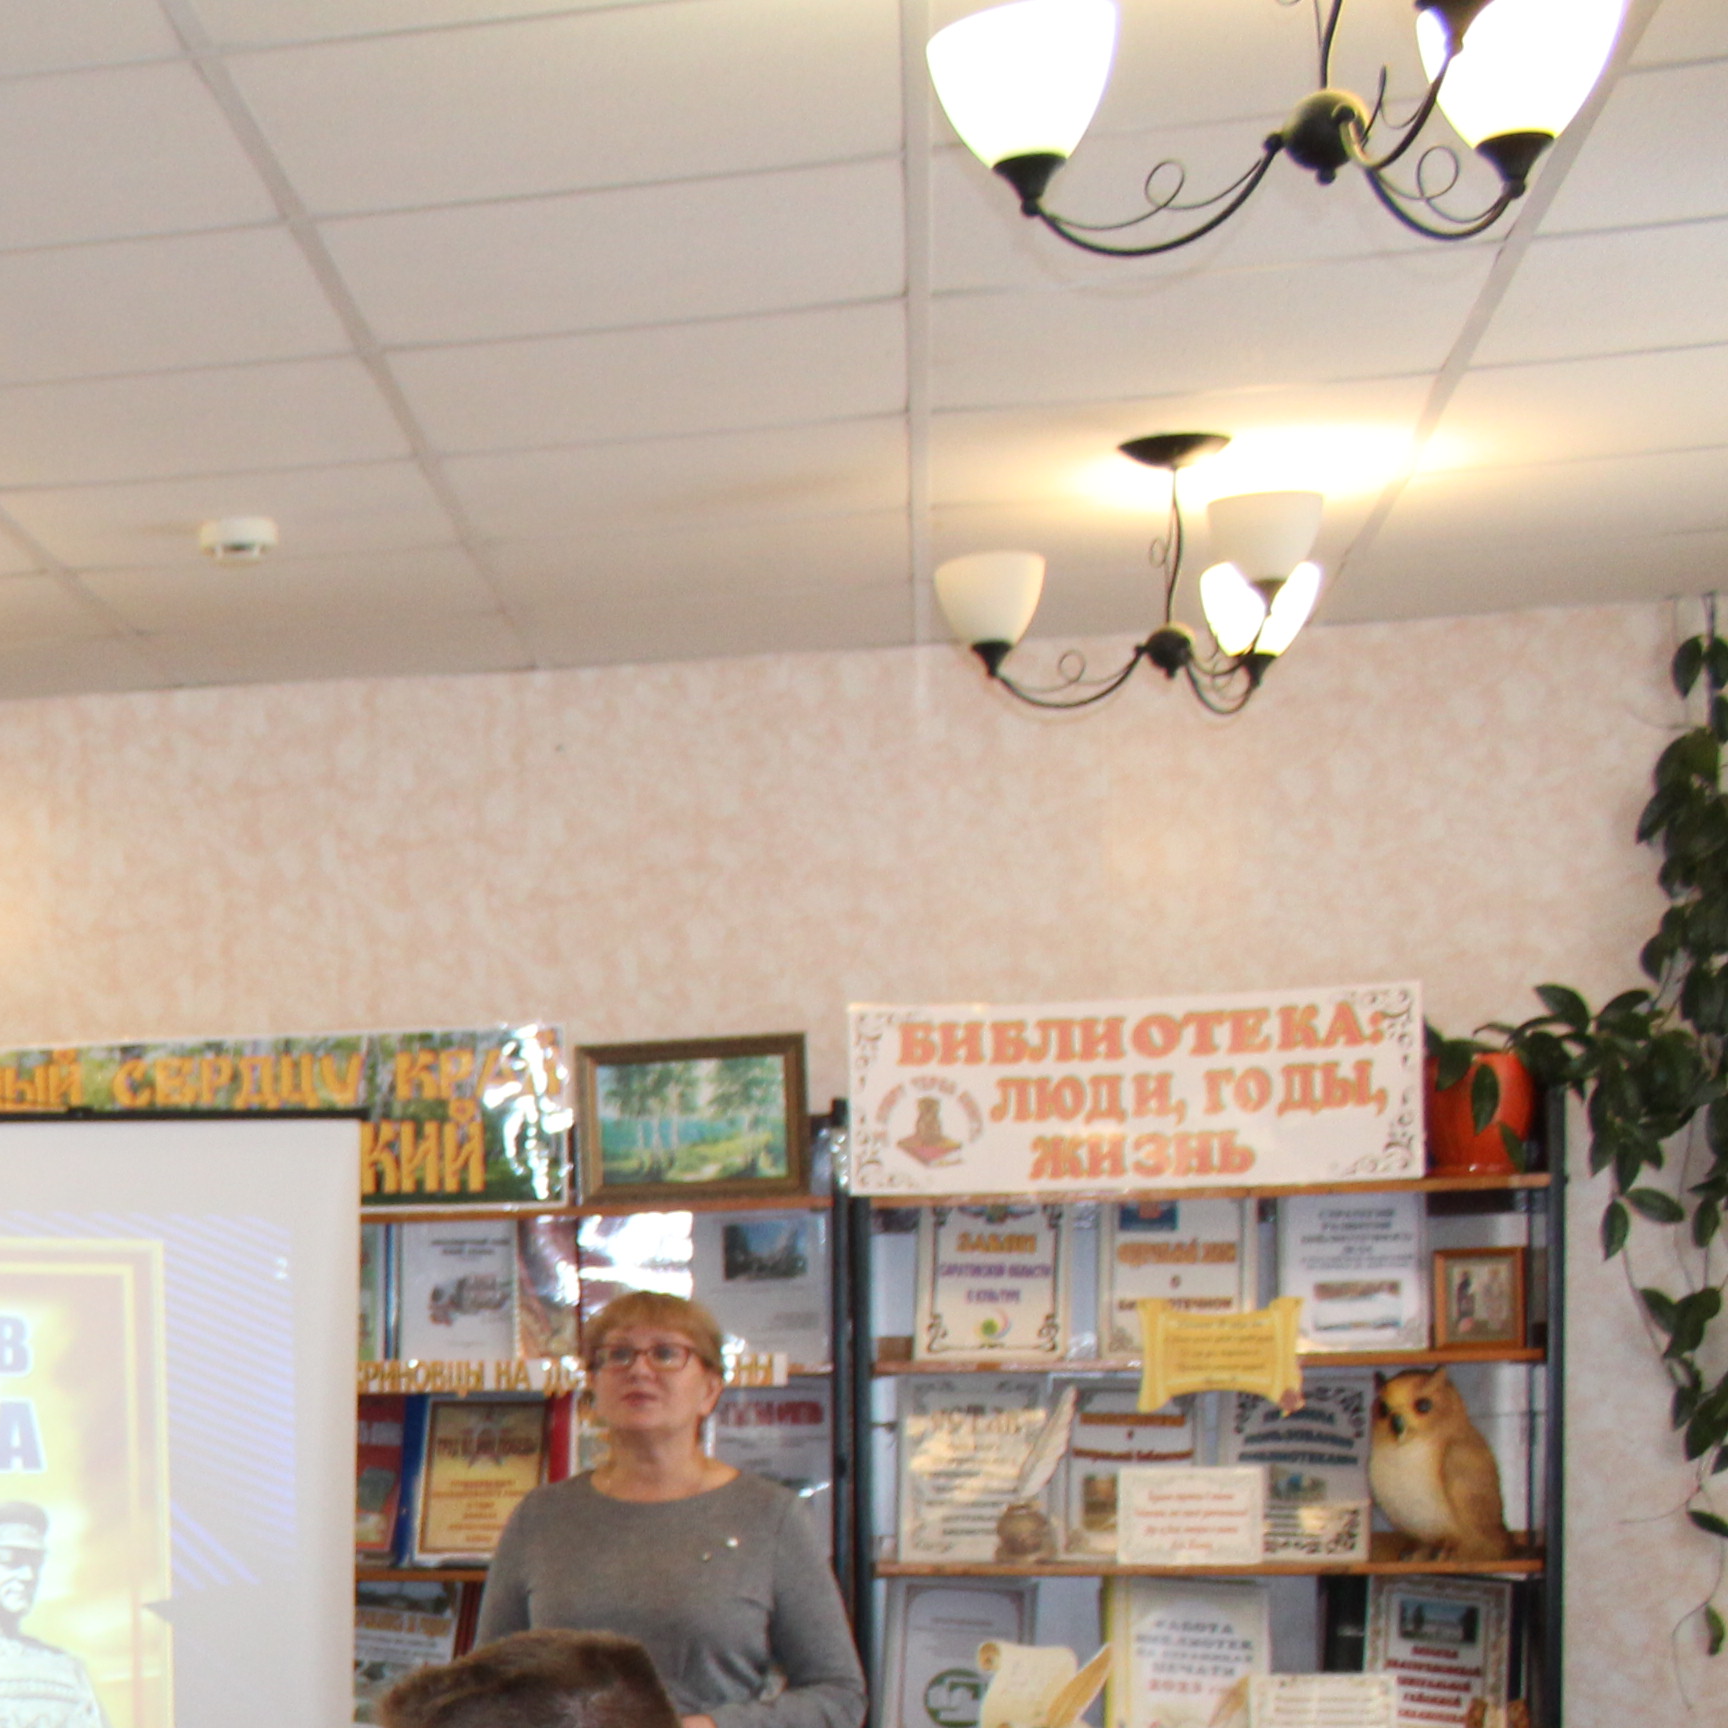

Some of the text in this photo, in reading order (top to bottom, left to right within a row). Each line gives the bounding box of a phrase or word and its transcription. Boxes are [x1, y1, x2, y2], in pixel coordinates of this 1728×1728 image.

[112, 1053, 365, 1110] СЕРДЦУ
[990, 1073, 1185, 1126] ЛЮДИ,
[1204, 1059, 1388, 1117] ГОДЫ,
[360, 1101, 484, 1194] КИЙ
[1029, 1130, 1255, 1181] ЖИЗНЬ
[357, 1359, 485, 1398] РИНОВЦЫ
[495, 1359, 531, 1391] НА
